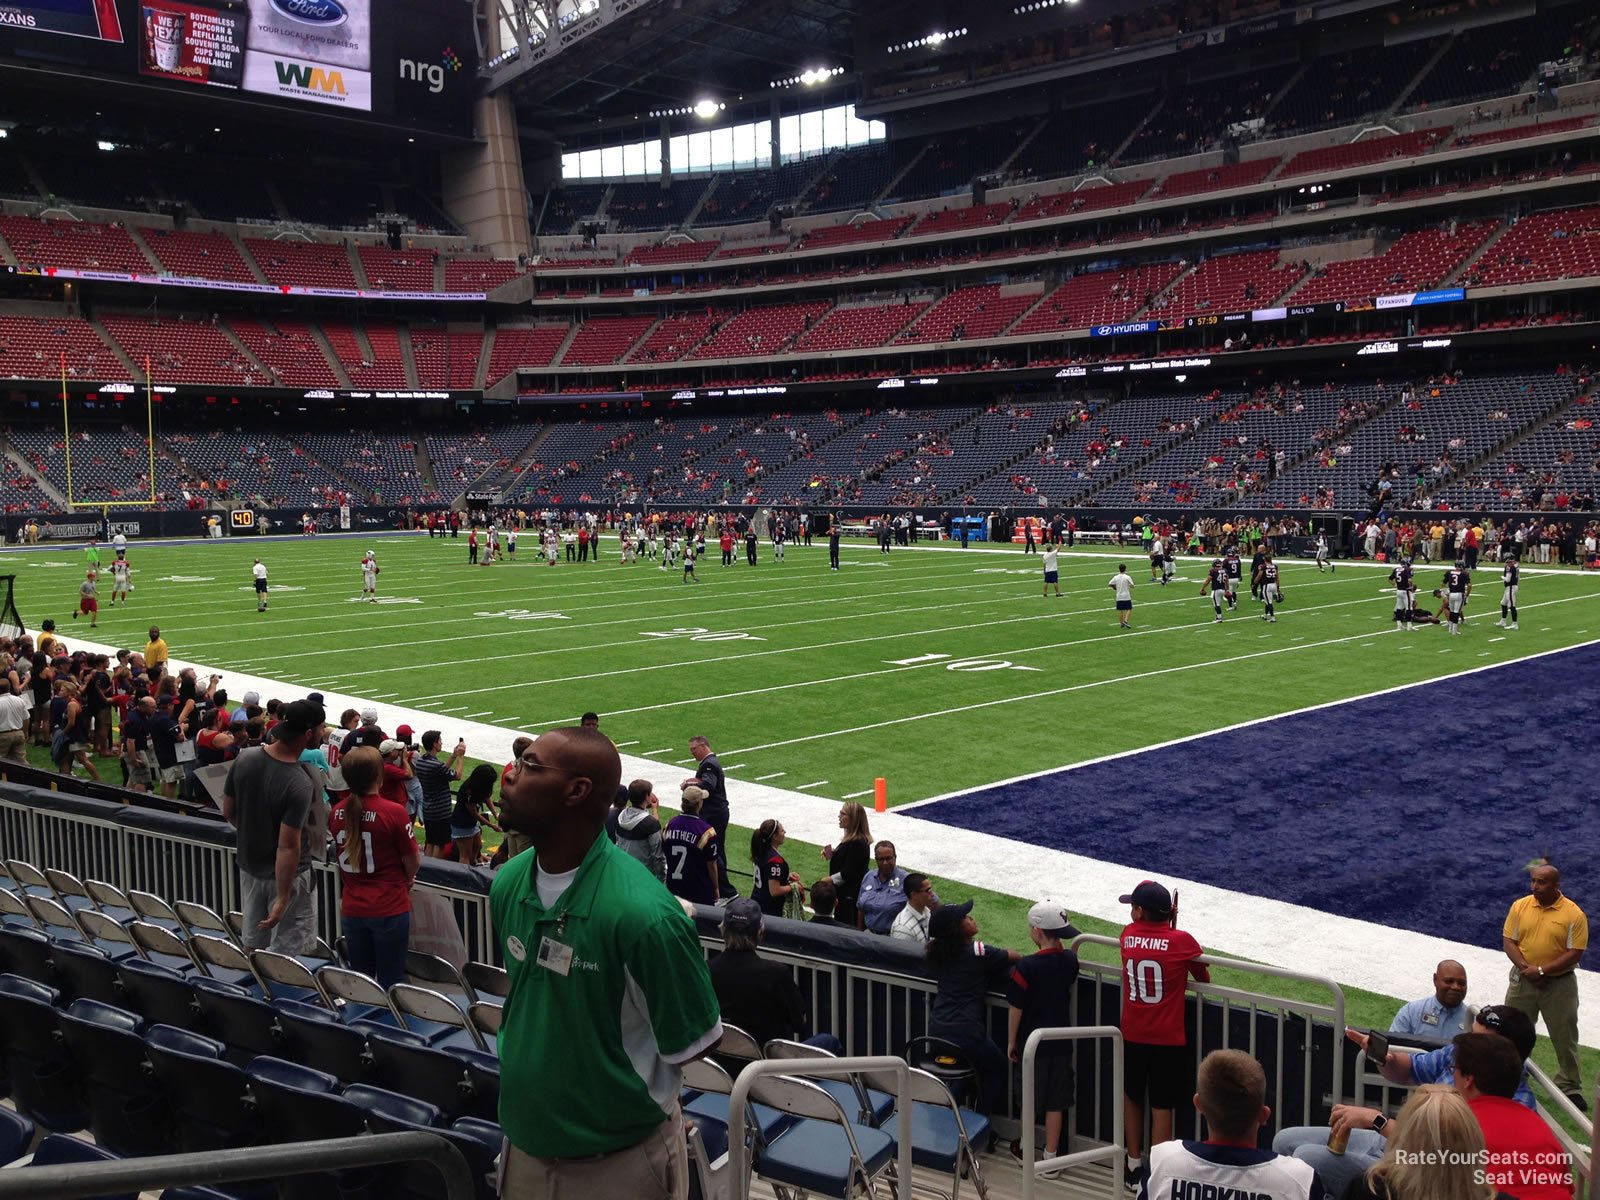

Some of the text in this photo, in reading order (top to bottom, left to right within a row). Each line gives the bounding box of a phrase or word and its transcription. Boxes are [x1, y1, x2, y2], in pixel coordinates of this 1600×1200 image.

[158, 16, 172, 27] WE
[190, 12, 235, 28] BOTTOMLESS
[192, 21, 233, 36] POPCORN &
[258, 24, 280, 34] YOUR
[280, 30, 304, 40] LOCAL
[192, 30, 233, 44] REFILLABLE
[185, 37, 240, 53] SOUVENIR SODA
[194, 47, 231, 60] CUPS NOW
[193, 55, 233, 69] AVAILABLE!
[274, 60, 346, 96] WM
[400, 58, 444, 93] nrg
[279, 86, 346, 102] WASTE MANAGEMENT
[1336, 303, 1341, 311] 0
[1113, 323, 1149, 333] HYUNDAI
[1188, 318, 1193, 326] 0
[1197, 316, 1218, 326] 57:59
[234, 511, 251, 525] 40
[1231, 564, 1237, 573] 9
[1451, 574, 1459, 586] 3
[328, 744, 339, 768] 10
[334, 809, 377, 823] PESON
[666, 829, 697, 844] MATHIEU
[336, 829, 375, 874] 21
[711, 843, 718, 856] 7
[671, 845, 688, 880] 7
[771, 866, 781, 877] 99
[1124, 935, 1170, 951] HOPKINS
[1126, 958, 1163, 1004] 10
[1171, 1178, 1273, 1200] HOPK
